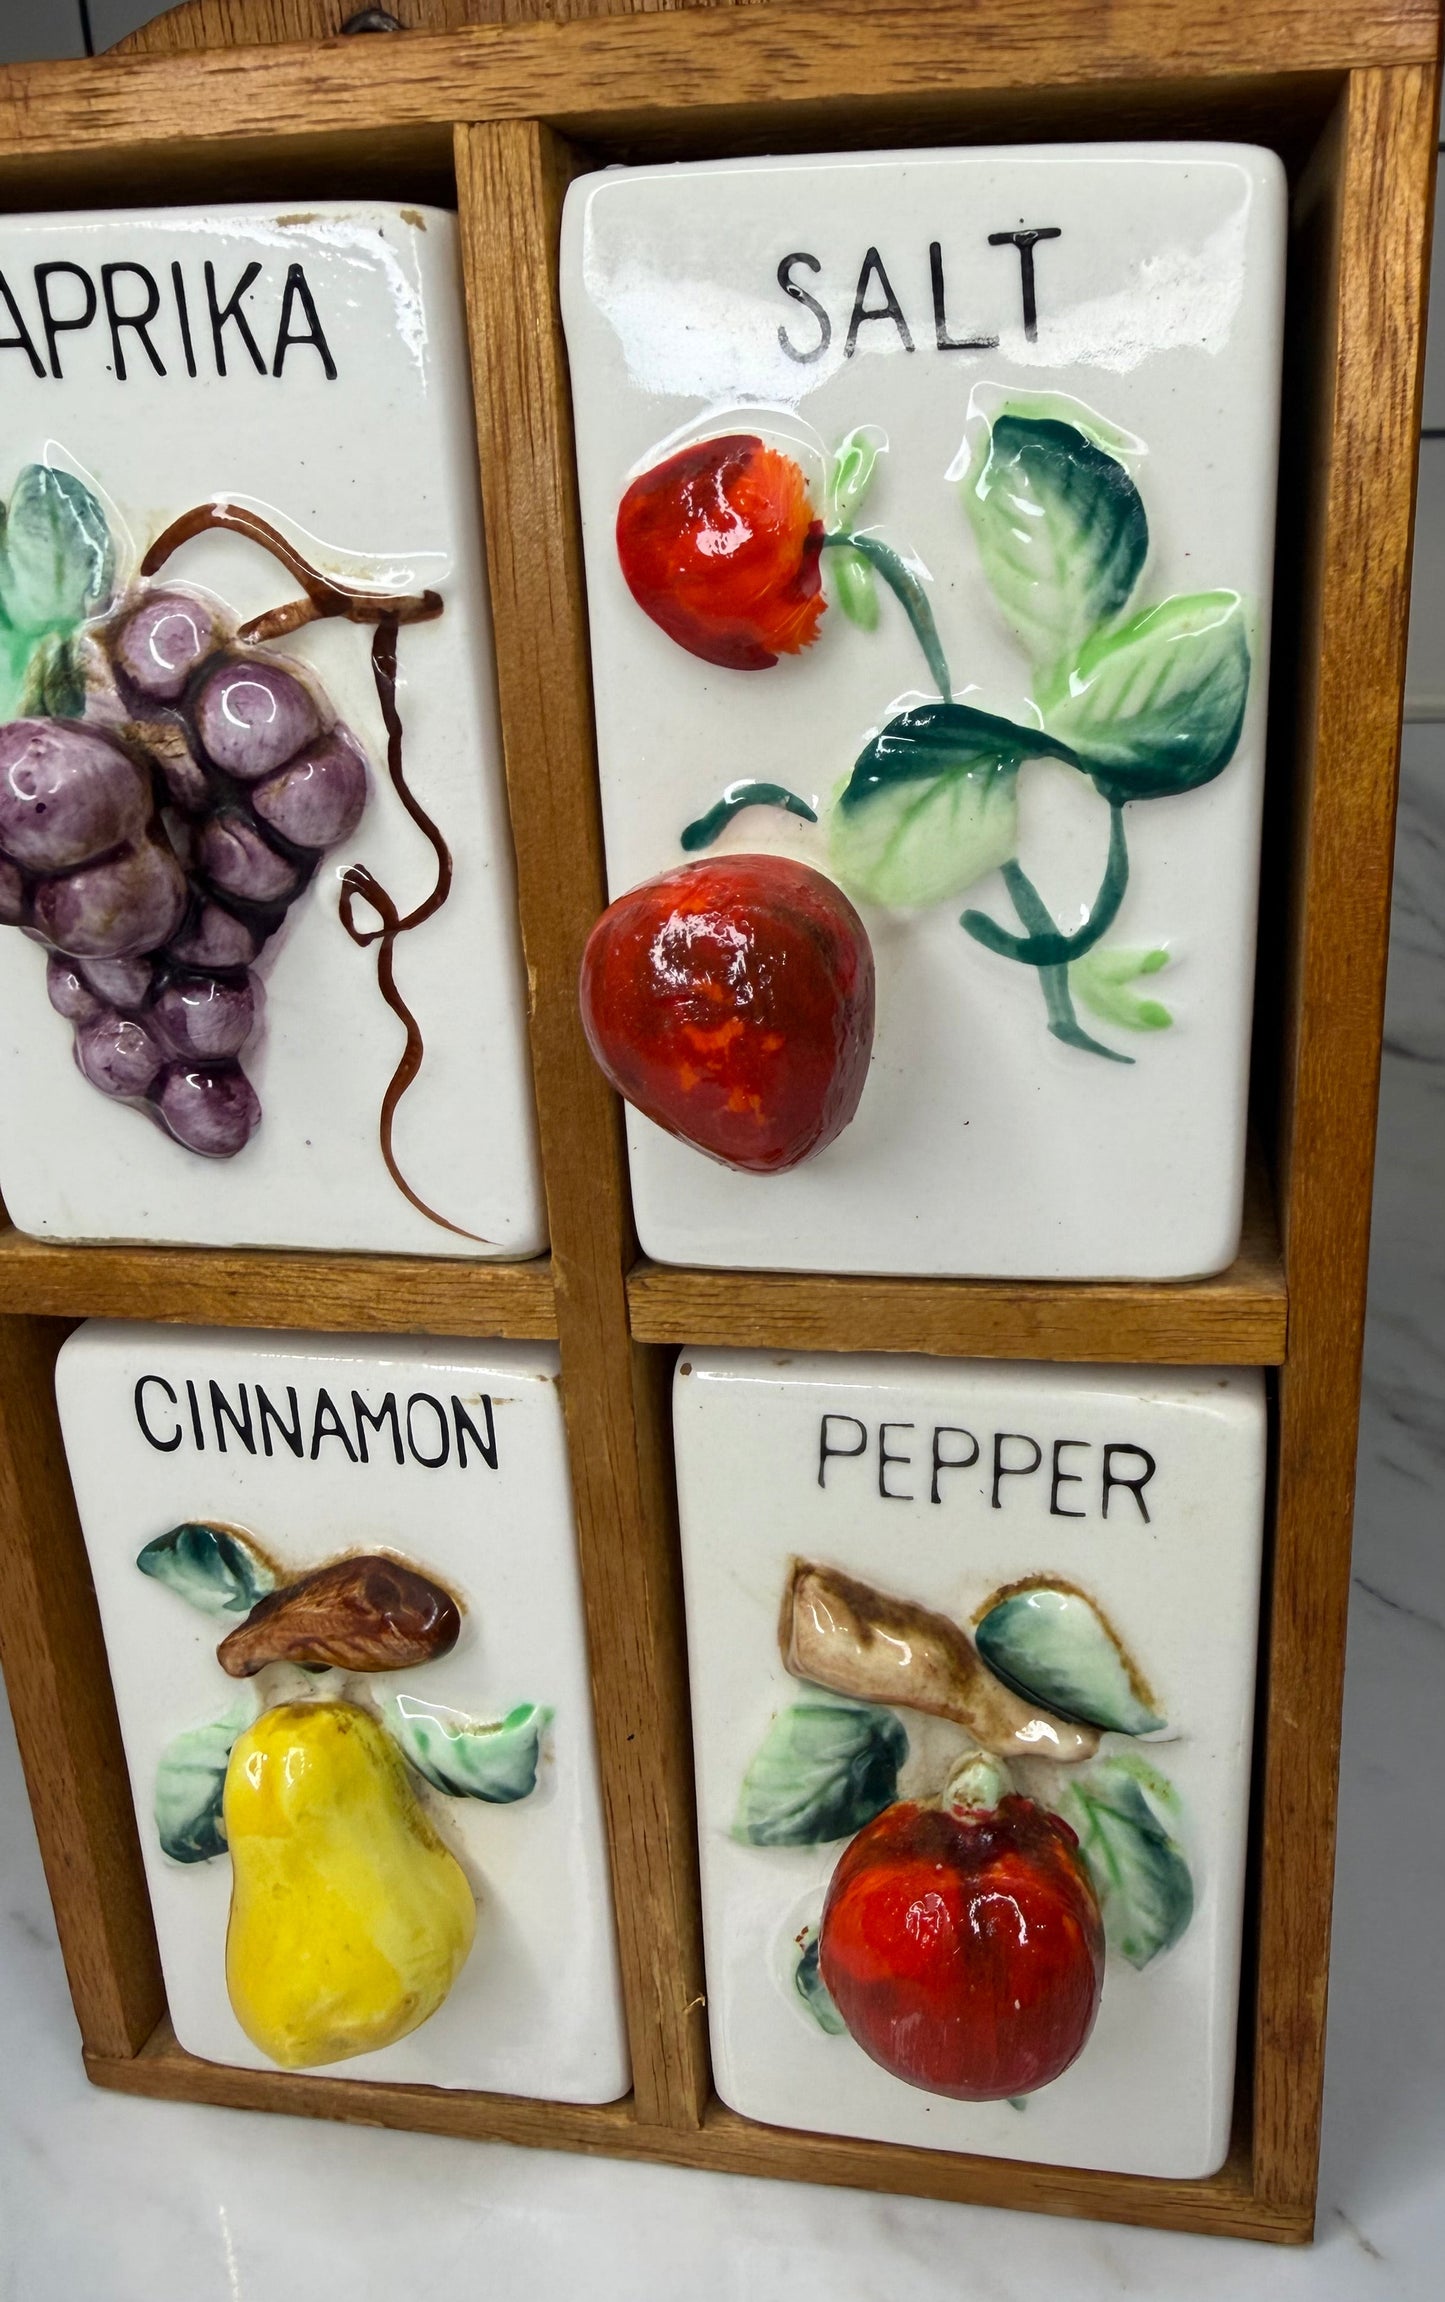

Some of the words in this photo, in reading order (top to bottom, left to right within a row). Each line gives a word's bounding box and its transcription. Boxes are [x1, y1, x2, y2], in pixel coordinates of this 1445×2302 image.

[777, 227, 1062, 364] SALT
[134, 1374, 499, 1470] CINNAMON
[817, 1414, 1157, 1524] PEPPER
